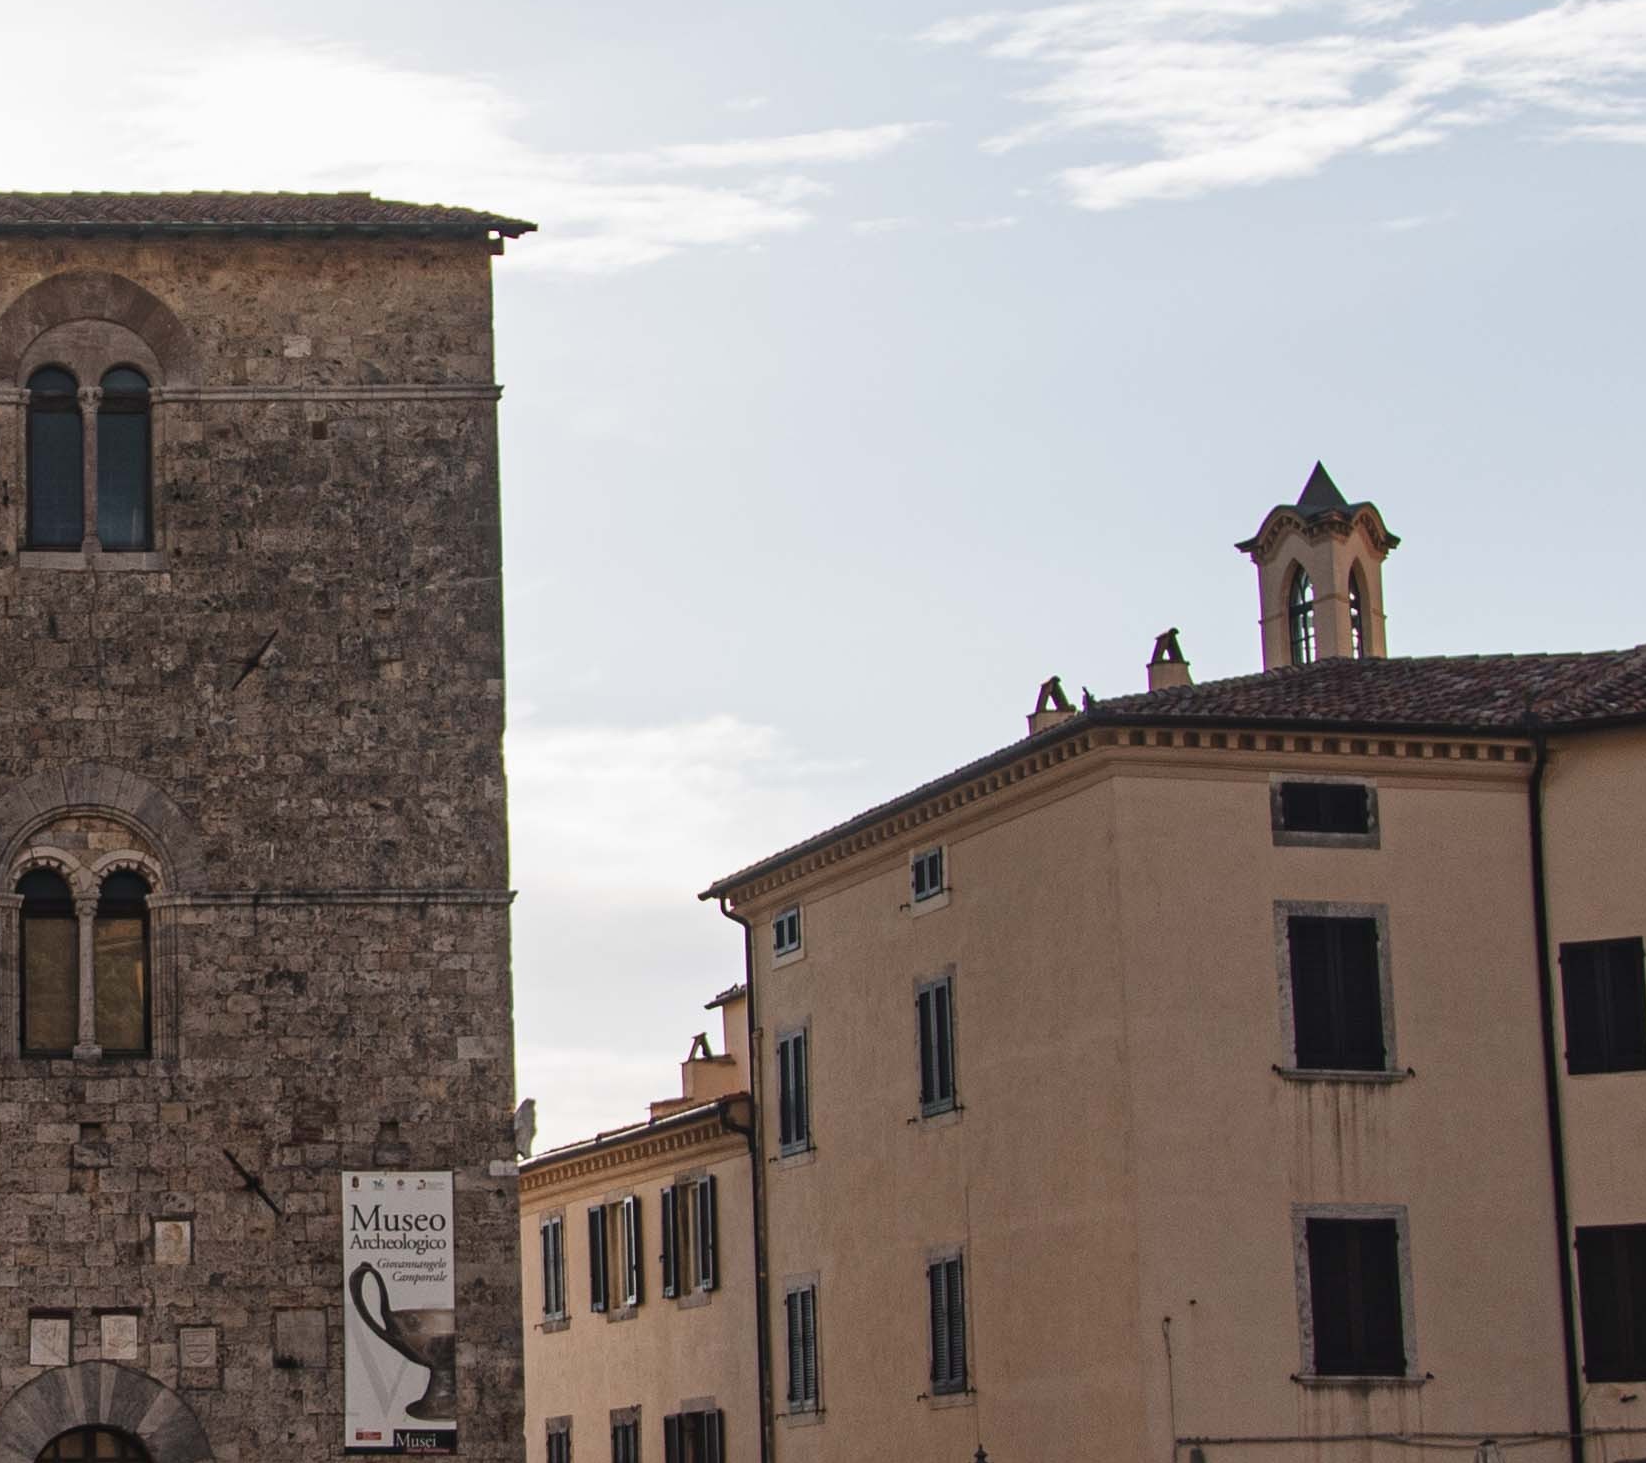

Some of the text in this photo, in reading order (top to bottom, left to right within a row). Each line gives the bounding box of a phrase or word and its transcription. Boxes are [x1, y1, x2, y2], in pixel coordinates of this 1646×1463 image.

[350, 1203, 446, 1232] Museo
[349, 1232, 446, 1255] Archeologico
[377, 1257, 446, 1272] Giovannangelo
[392, 1270, 447, 1286] Camporeale
[396, 1432, 436, 1448] Musei
